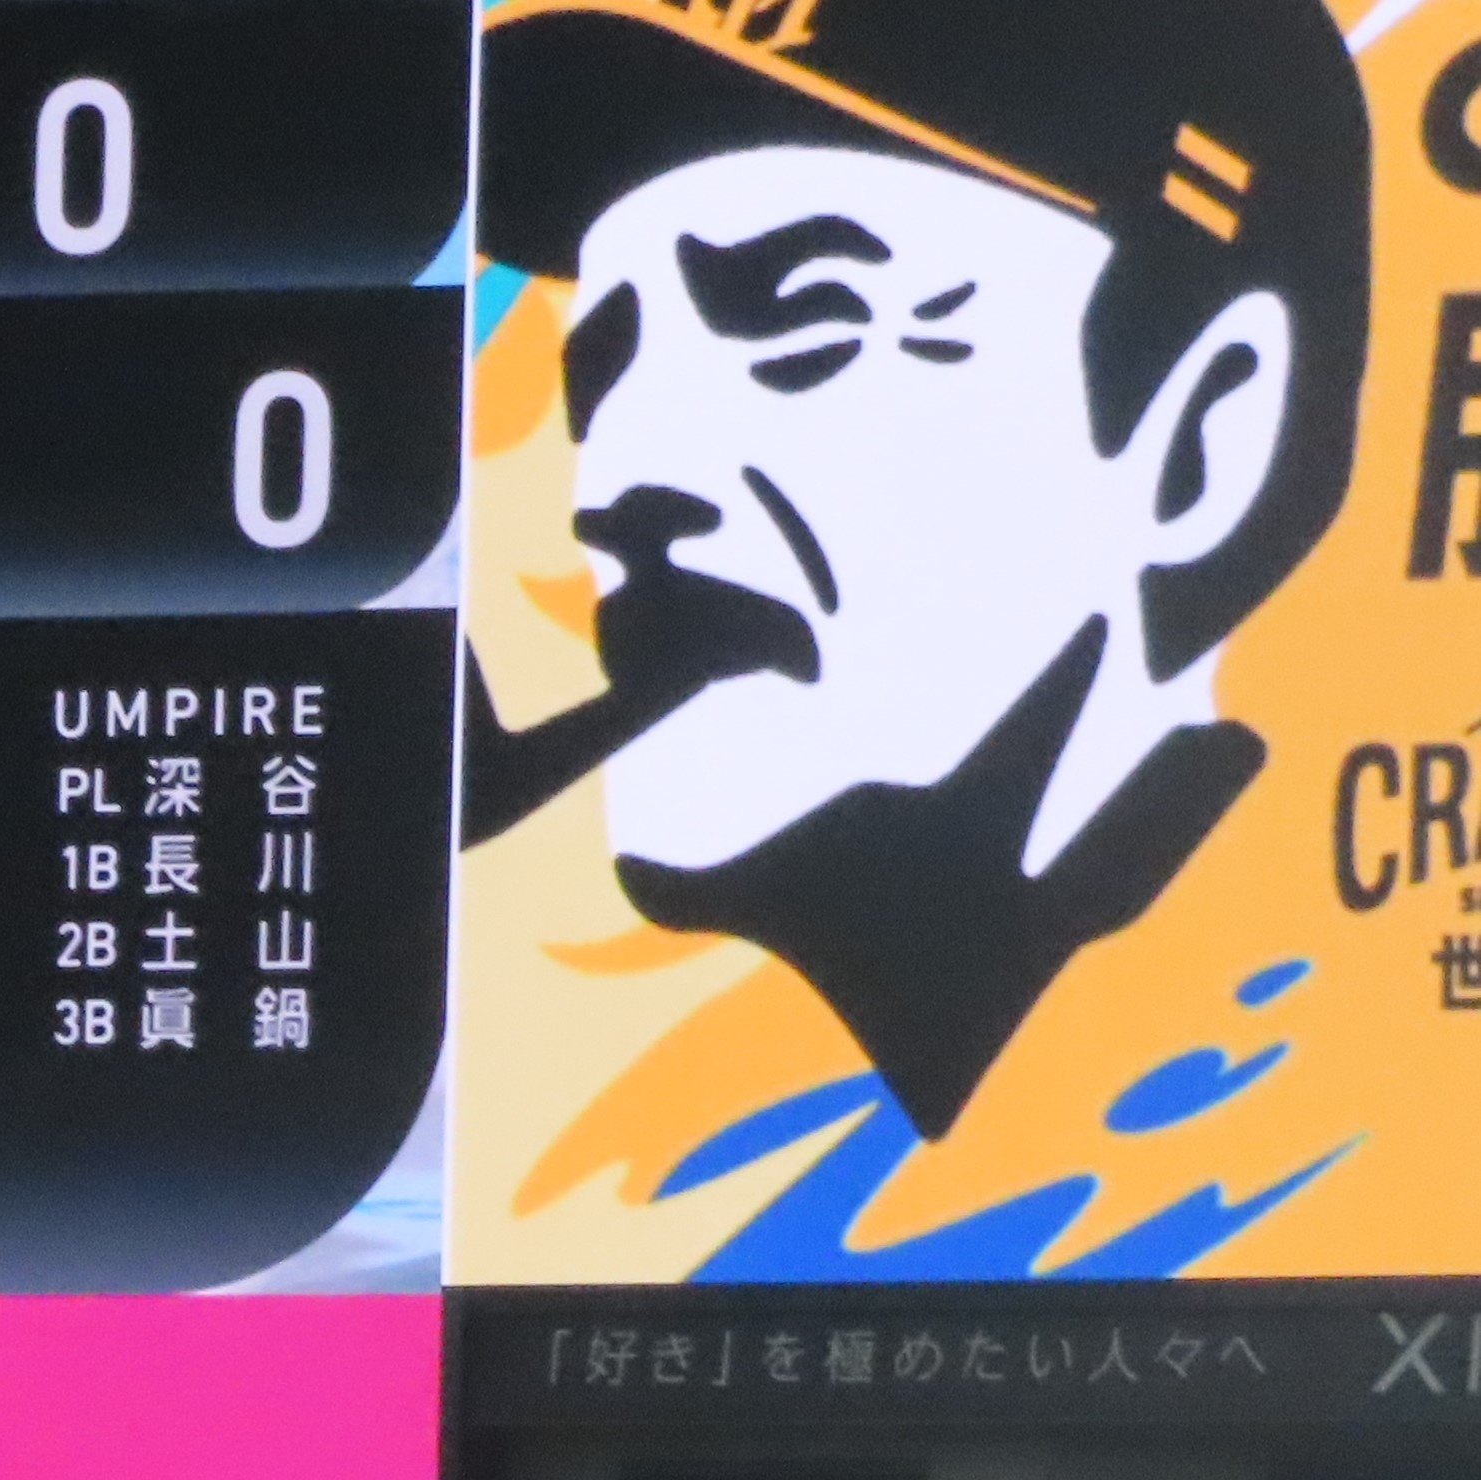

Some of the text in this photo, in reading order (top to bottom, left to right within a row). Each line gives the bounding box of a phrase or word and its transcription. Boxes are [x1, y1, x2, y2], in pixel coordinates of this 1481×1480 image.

[34, 77, 133, 256] 0
[233, 369, 333, 549] 0
[55, 685, 324, 739] UMPIRE
[59, 767, 122, 813] PL
[1333, 741, 1481, 912] CR
[63, 844, 119, 890] 1B
[57, 921, 117, 968] 2B
[54, 998, 115, 1045] 3B
